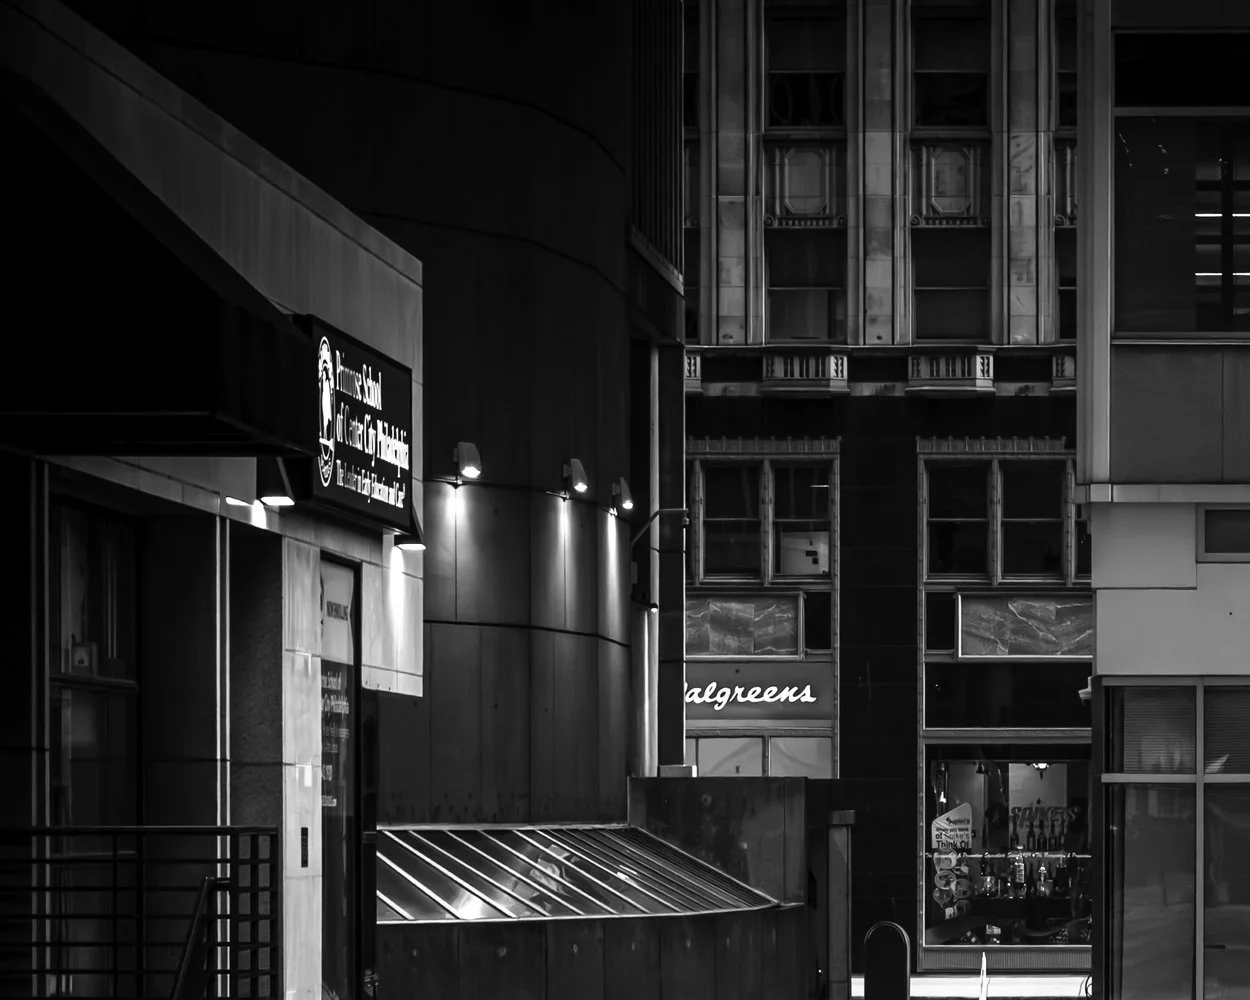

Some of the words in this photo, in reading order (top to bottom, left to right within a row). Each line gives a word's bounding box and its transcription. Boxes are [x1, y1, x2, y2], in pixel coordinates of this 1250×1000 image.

[336, 402, 344, 443] of
[364, 413, 376, 468] City
[684, 682, 817, 711] algreens
